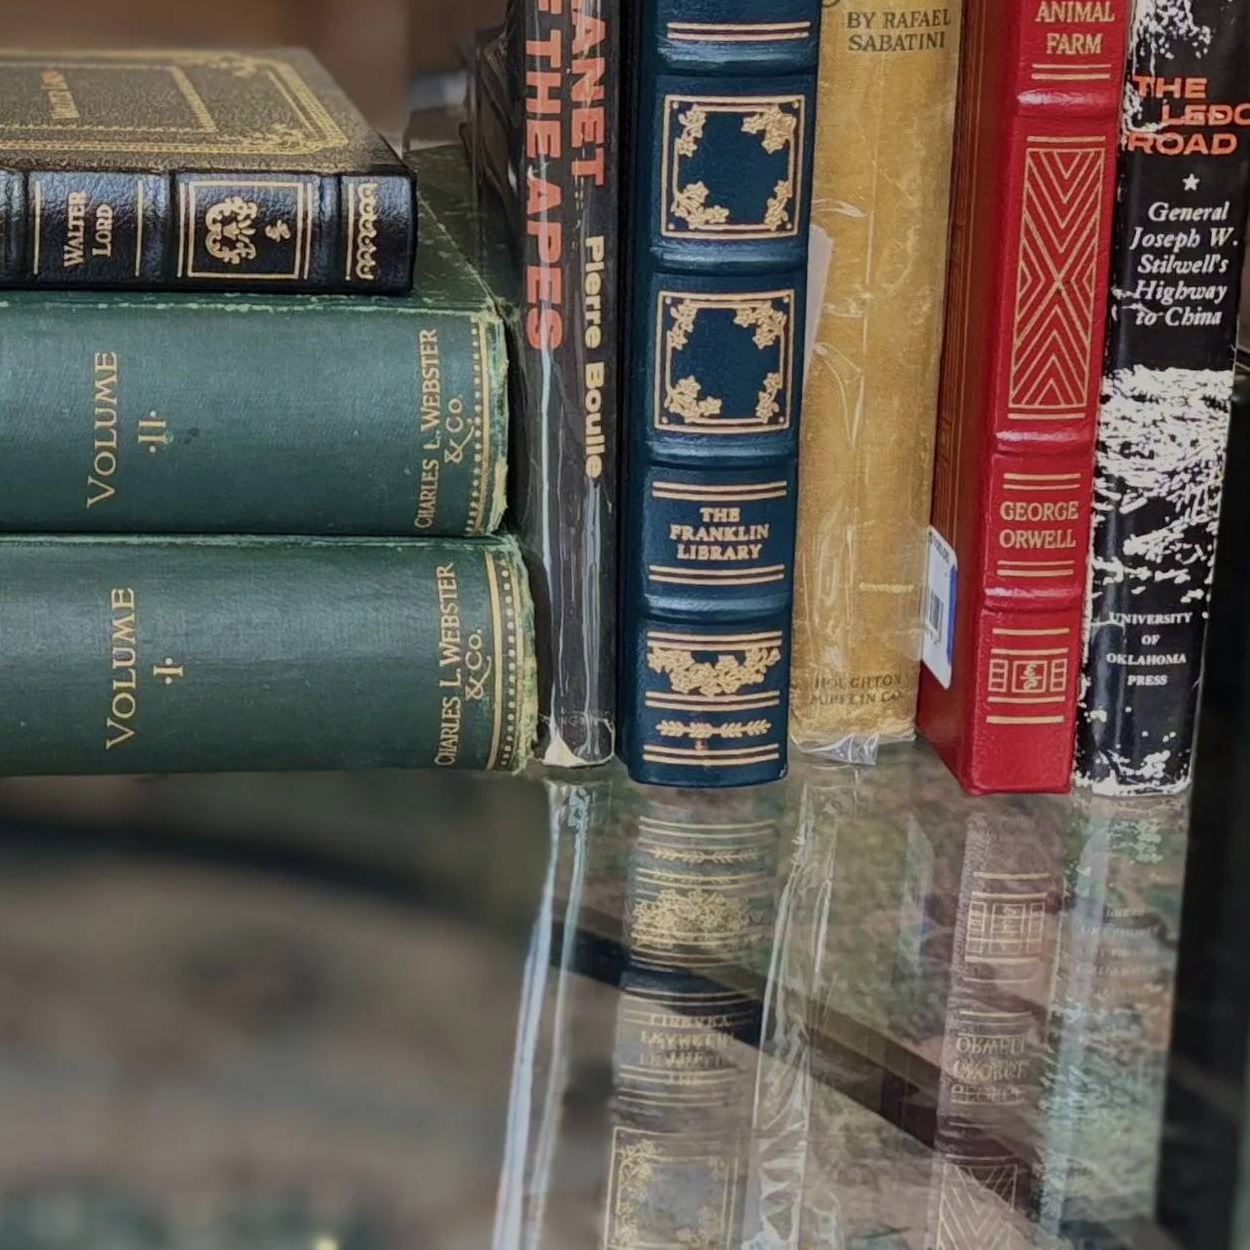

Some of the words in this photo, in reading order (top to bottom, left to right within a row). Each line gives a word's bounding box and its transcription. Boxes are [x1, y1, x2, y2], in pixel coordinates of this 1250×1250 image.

[847, 11, 876, 29] BY
[883, 8, 951, 29] RAFAEL
[1035, 0, 1115, 23] ANIMAL
[848, 31, 945, 51] SABATINI
[1046, 33, 1103, 55] FARM
[525, 29, 562, 159] THE
[1132, 74, 1208, 99] THE
[1127, 131, 1237, 155] ROAD
[1148, 201, 1230, 222] General
[63, 190, 87, 267] WALTER
[92, 204, 114, 257] LORD
[1129, 226, 1200, 253] Joseph
[1209, 226, 1239, 248] W.
[526, 177, 564, 350] APES
[1138, 253, 1229, 275] Stilwell's
[585, 236, 606, 349] Pierre
[1134, 279, 1228, 305] Highway
[1135, 307, 1158, 326] to
[1164, 306, 1223, 326] China
[419, 328, 441, 431] WEBSTER
[86, 351, 119, 509] VOLUME
[585, 361, 607, 479] Boulle
[444, 418, 475, 464] &
[414, 459, 440, 529] CHARLES
[700, 507, 740, 522] THE
[1000, 501, 1079, 521] GEORGE
[669, 523, 769, 541] FRANKLIN
[1000, 529, 1076, 549] ORWELL
[677, 544, 762, 561] LIBRARY
[437, 563, 462, 667] WEBSTER
[1109, 612, 1193, 625] UNIVERSITY
[1141, 635, 1160, 645] OF
[106, 587, 137, 750] VOLUME
[1106, 653, 1187, 665] OKLAHOMA
[465, 655, 492, 700] &
[1127, 675, 1168, 686] PRESS
[434, 696, 462, 766] CHARLES
